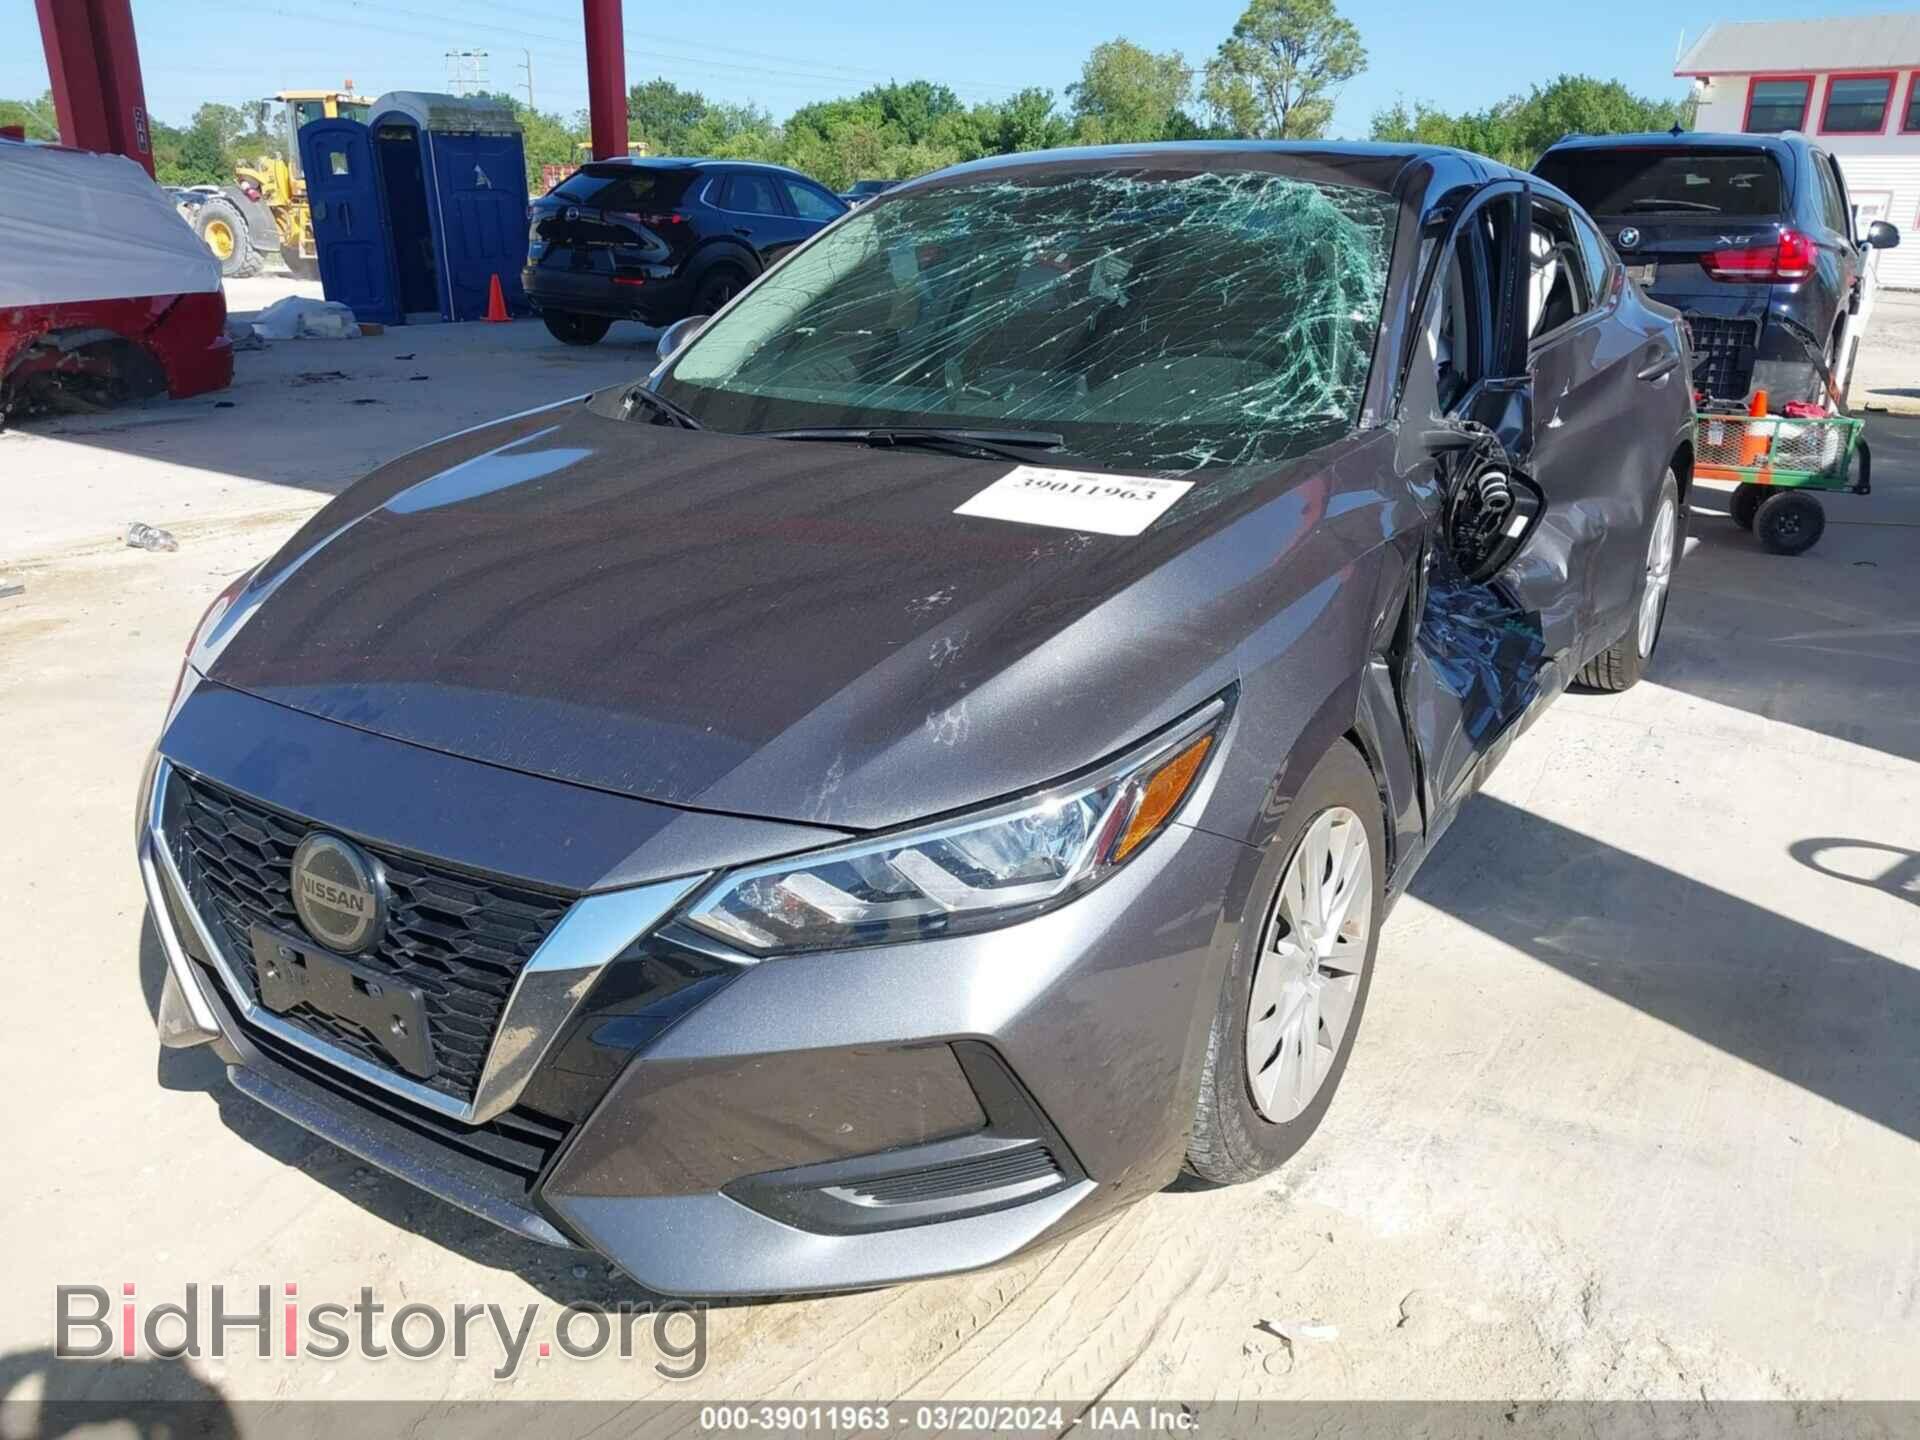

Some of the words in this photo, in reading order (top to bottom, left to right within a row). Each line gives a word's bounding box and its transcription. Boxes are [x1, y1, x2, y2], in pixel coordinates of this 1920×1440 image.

[1715, 234, 1754, 246] X5
[1013, 477, 1157, 501] 39011963
[302, 876, 365, 913] NISSAN
